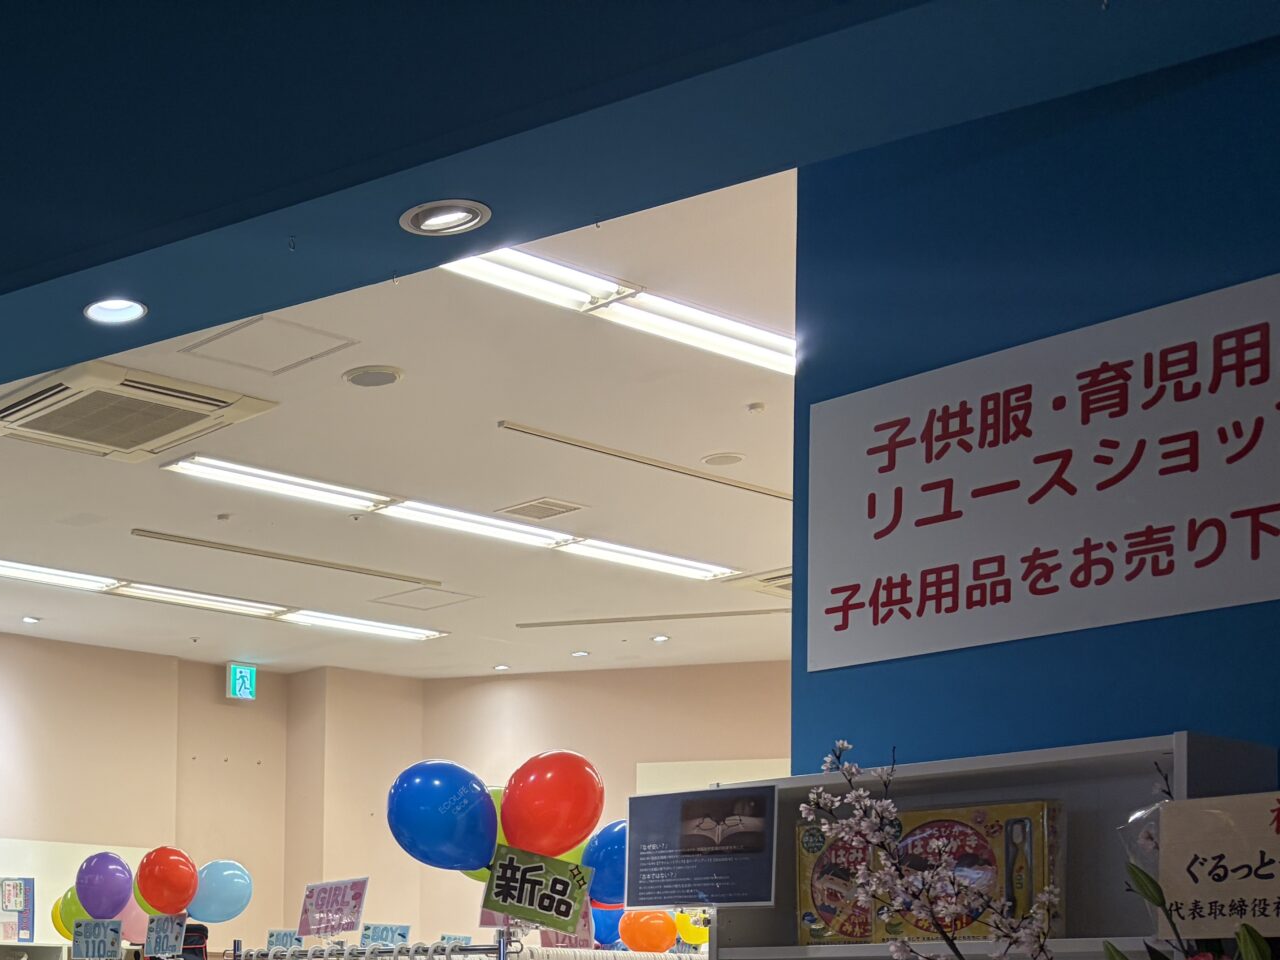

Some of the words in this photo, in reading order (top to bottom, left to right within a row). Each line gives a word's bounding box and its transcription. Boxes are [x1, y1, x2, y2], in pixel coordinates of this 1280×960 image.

[866, 322, 1270, 474] 子供服・育児用
[867, 401, 1280, 540] リユースショッ
[824, 502, 1280, 632] 子供用品をお売り下
[493, 856, 573, 918] 新品
[1186, 850, 1276, 884] ぐるっと
[314, 884, 351, 910] GIRL
[83, 922, 110, 939] BOY
[371, 928, 398, 942] BOY
